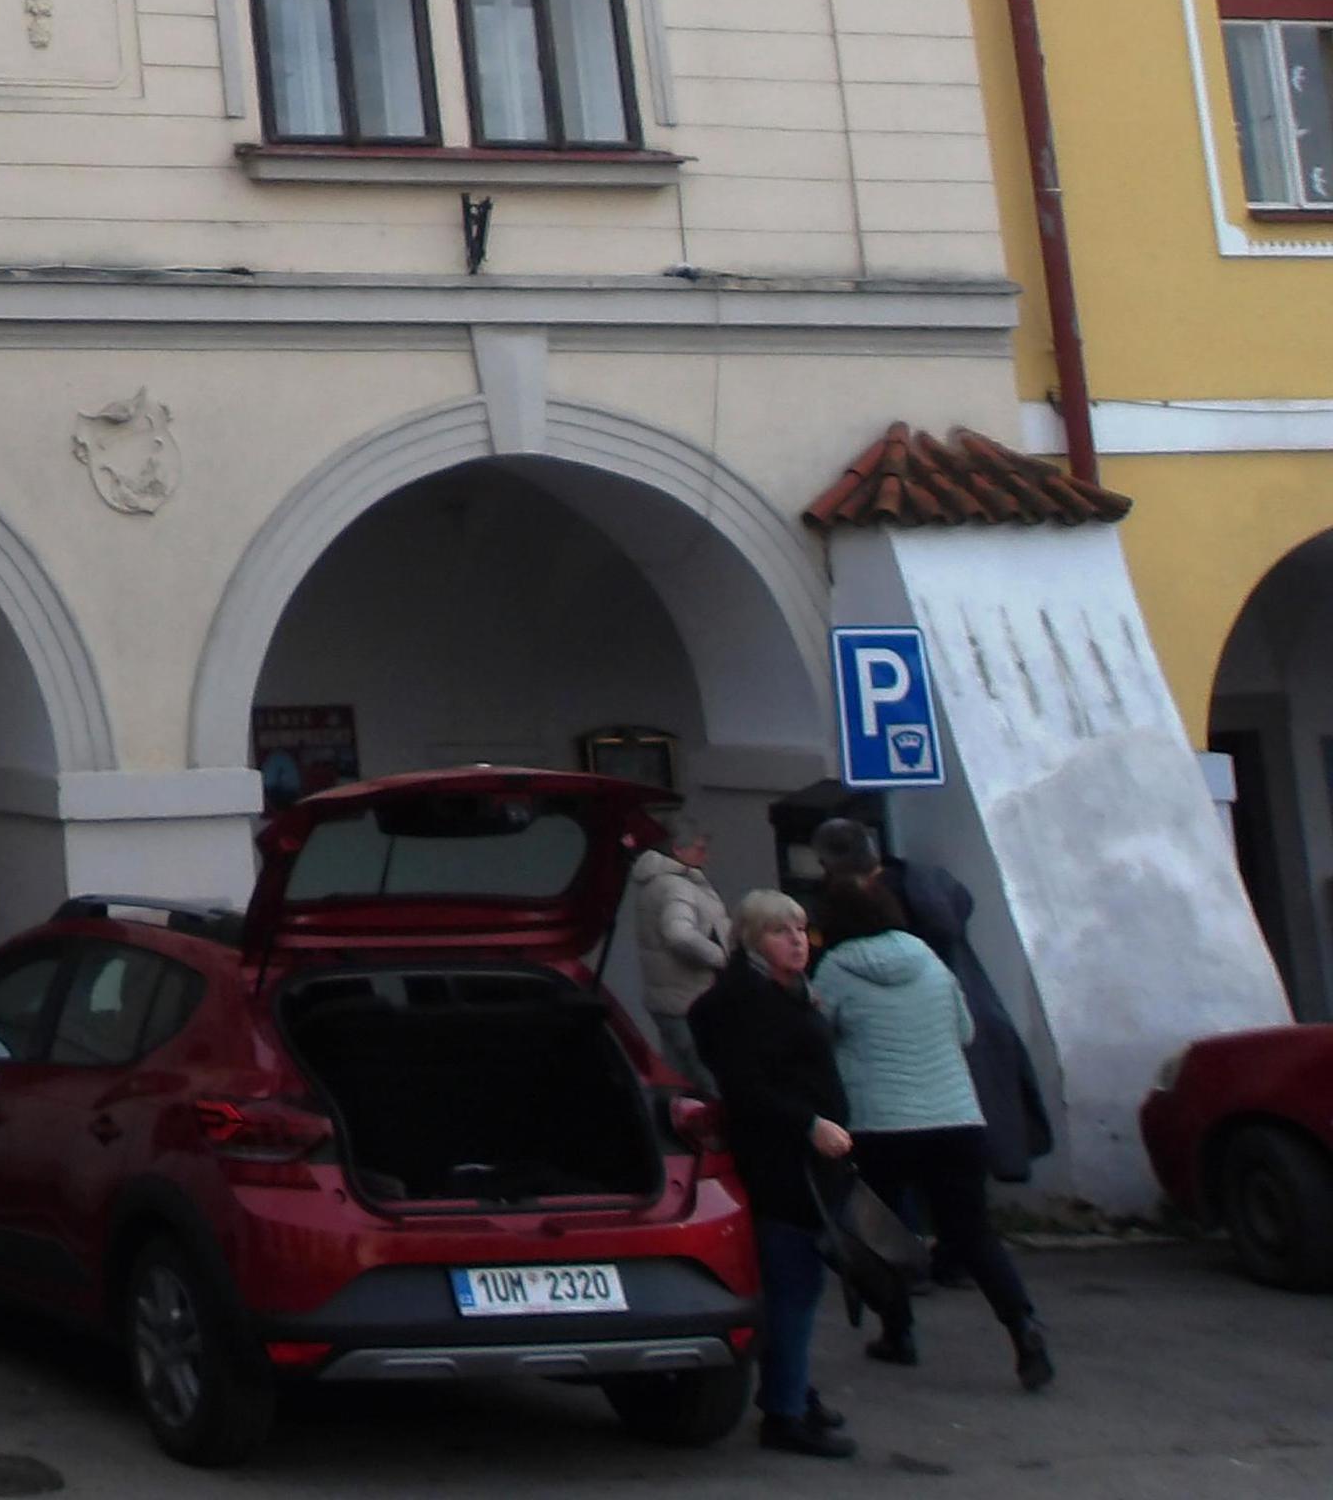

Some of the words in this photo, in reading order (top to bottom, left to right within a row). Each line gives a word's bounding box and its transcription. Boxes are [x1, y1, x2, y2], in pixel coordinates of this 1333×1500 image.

[855, 648, 911, 737] P
[477, 1271, 529, 1303] 1UM
[545, 1270, 611, 1302] 2320
